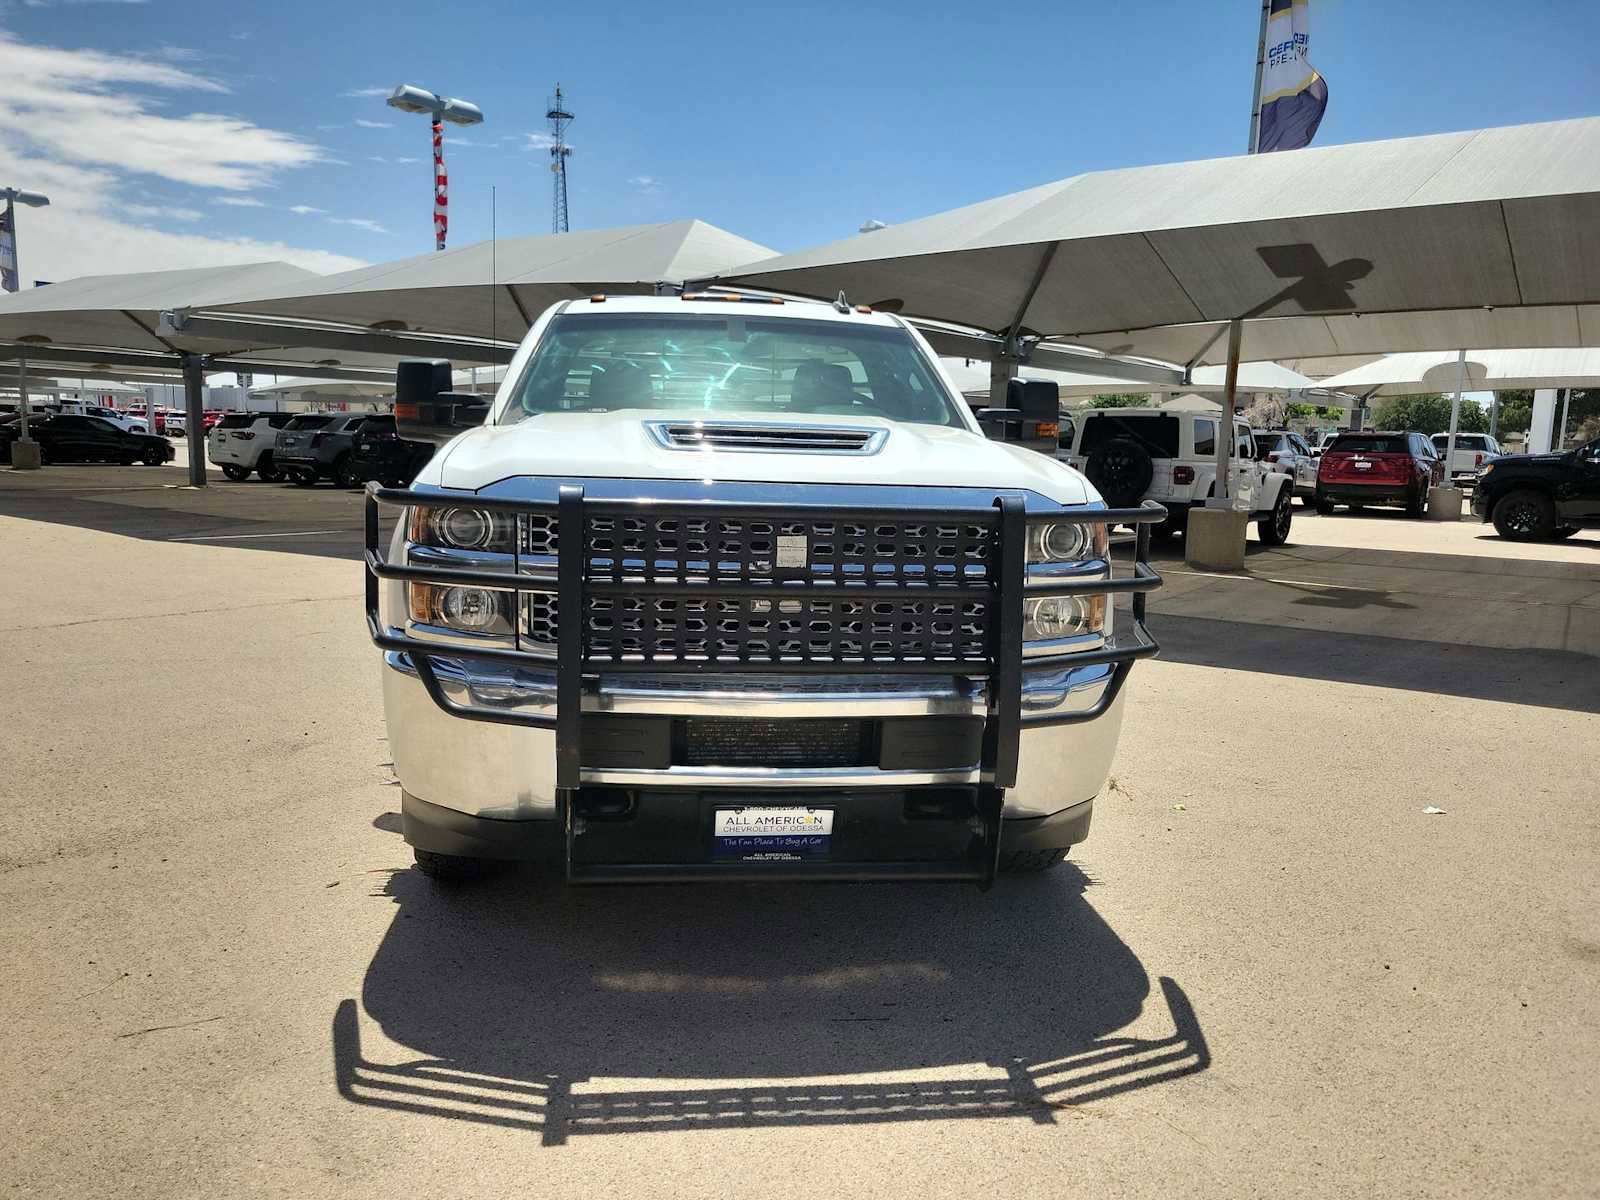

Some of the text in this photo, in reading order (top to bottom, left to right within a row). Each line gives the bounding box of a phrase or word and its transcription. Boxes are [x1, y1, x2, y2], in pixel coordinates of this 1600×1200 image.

[726, 816, 823, 825] ALL AMERICN
[724, 838, 737, 846] The
[753, 837, 774, 846] Place
[775, 837, 785, 845] To
[785, 837, 801, 847] Buy
[801, 837, 808, 845] A
[809, 837, 822, 845] Car
